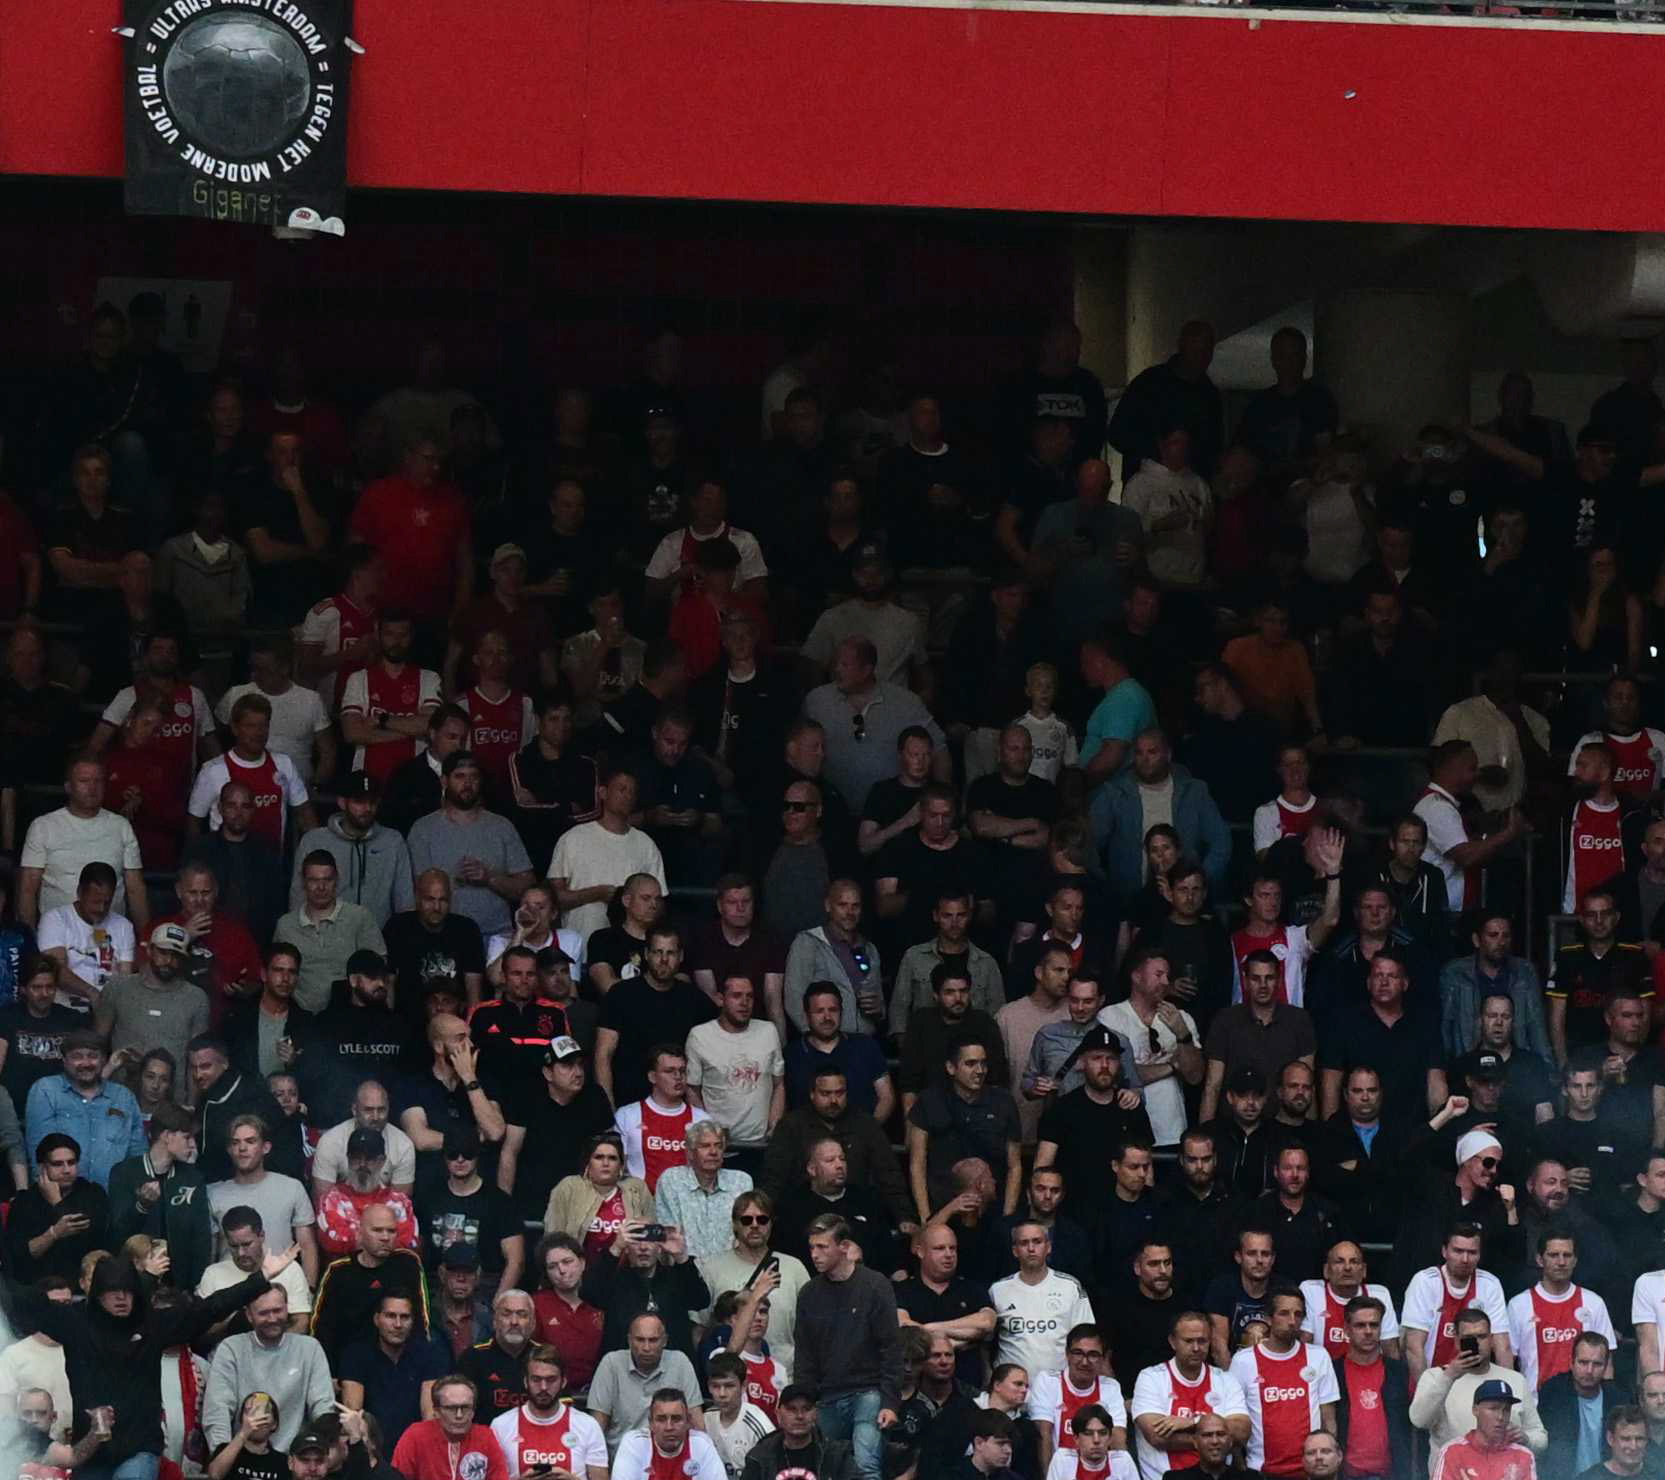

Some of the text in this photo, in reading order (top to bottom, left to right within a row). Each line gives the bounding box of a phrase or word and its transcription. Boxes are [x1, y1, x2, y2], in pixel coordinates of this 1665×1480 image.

[137, 63, 334, 182] TEGEN HET MODERNE VOETBAL
[160, 722, 192, 738] ggo
[254, 793, 278, 806] ggo
[1580, 834, 1622, 850] Ziggo
[1009, 1316, 1057, 1333] Ziggo
[493, 1390, 528, 1404] Zigg
[1264, 1384, 1305, 1402] Ziggo
[523, 1449, 567, 1464] Ziggo
